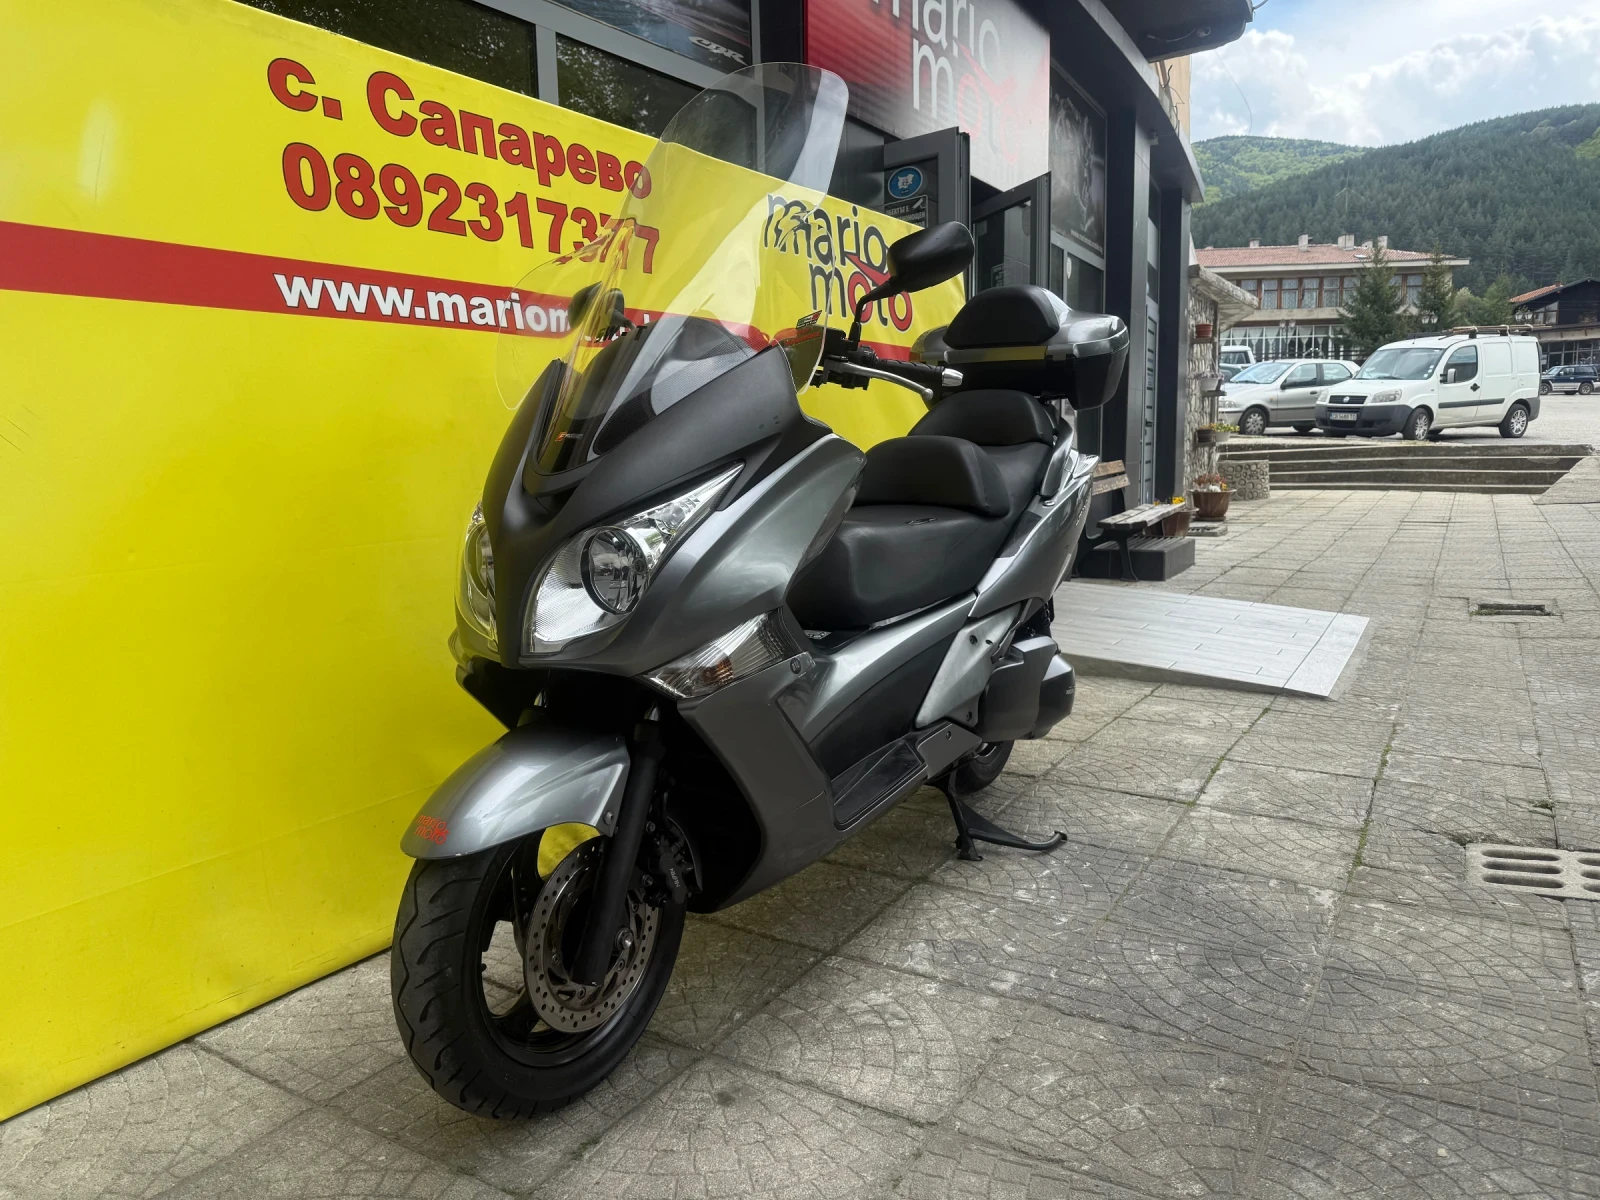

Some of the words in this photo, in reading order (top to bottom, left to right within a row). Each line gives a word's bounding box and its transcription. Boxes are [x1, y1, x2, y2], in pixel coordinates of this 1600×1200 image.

[688, 36, 748, 67] CBR
[267, 57, 343, 121] с.
[366, 70, 652, 199] Сапарево
[282, 142, 660, 275] 0892317377
[764, 194, 889, 274] mario
[809, 263, 913, 332] moto
[414, 826, 447, 845] moto
[415, 815, 447, 831] mario
